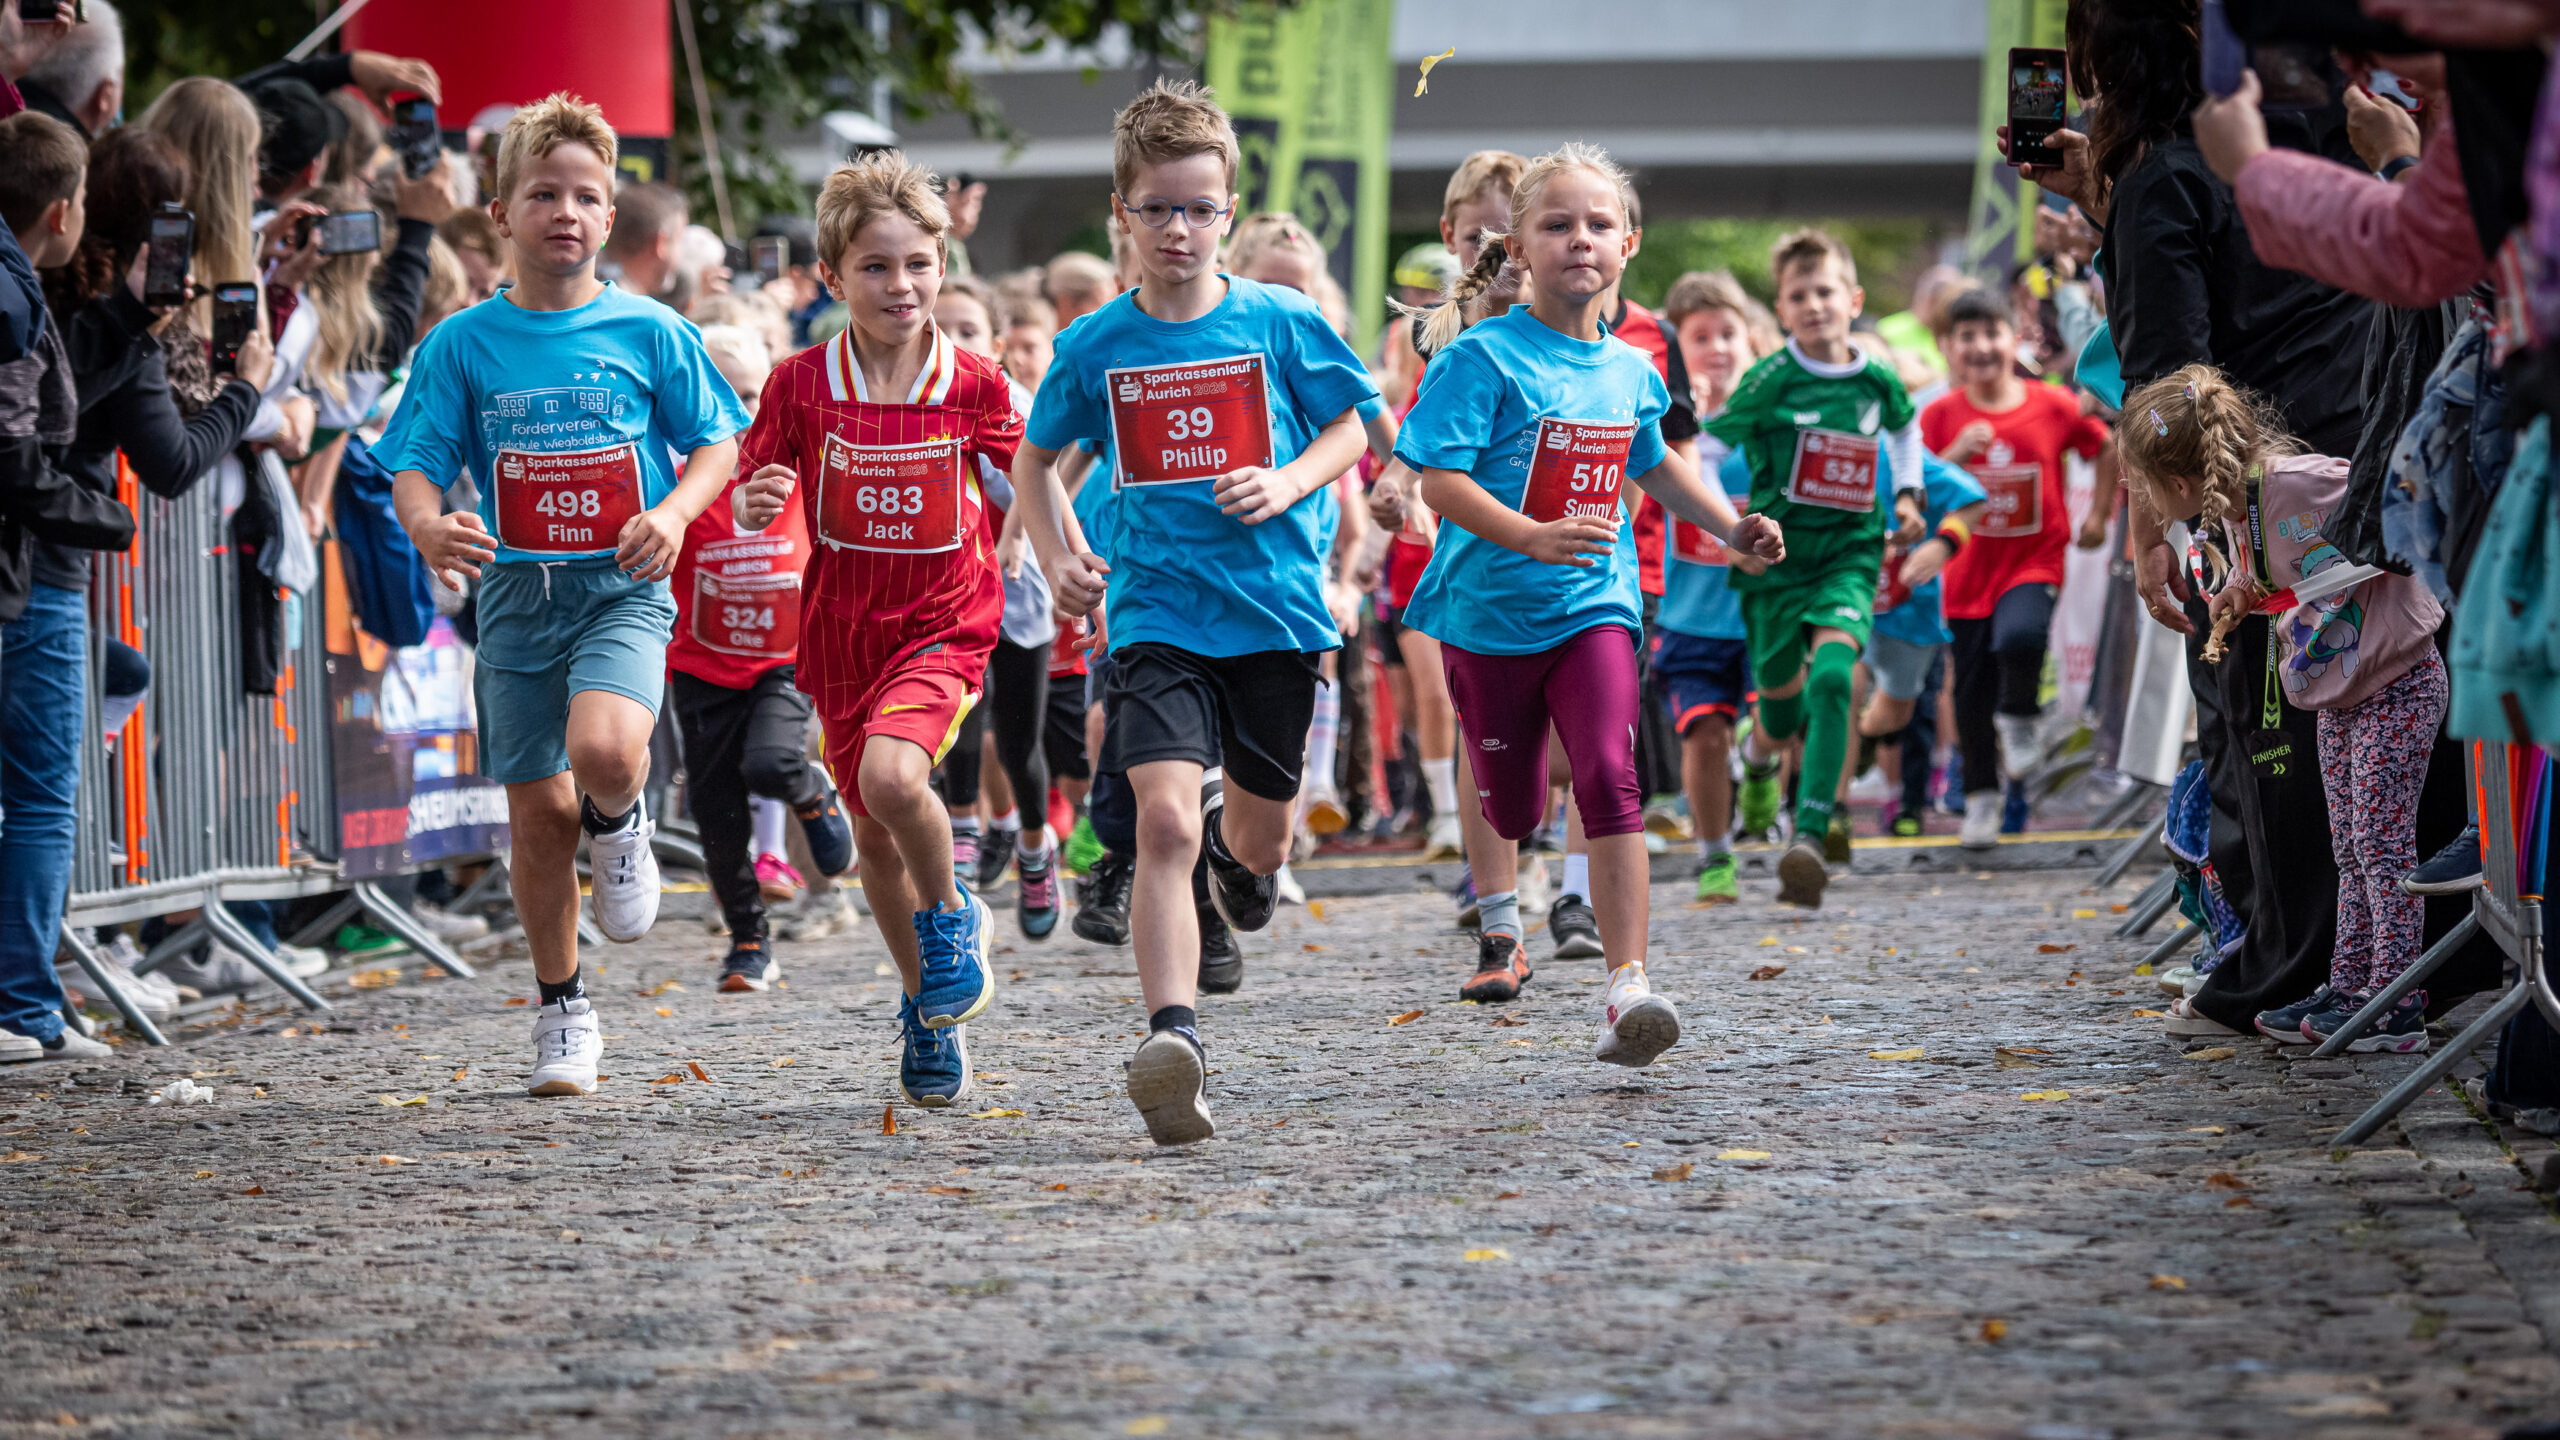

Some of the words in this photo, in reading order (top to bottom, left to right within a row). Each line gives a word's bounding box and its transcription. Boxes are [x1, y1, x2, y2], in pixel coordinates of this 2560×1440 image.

[1143, 360, 1251, 387] Sparkassenlauf
[1146, 385, 1191, 401] Aurich
[1193, 381, 1227, 396] 2026
[512, 418, 601, 436] Förderverein
[1166, 406, 1214, 440] 39
[543, 434, 615, 451] Wiegboldsbur
[1571, 442, 1607, 454] Aurich
[527, 448, 626, 471] Sparkassenlauf
[851, 446, 952, 464] Sparkassenlauf
[1161, 445, 1228, 470] Philip
[528, 470, 571, 482] Aurich
[851, 465, 896, 477] Aurich
[897, 464, 928, 477] 2026
[1570, 463, 1619, 492] 510
[1823, 458, 1870, 485] 524
[535, 489, 601, 518] 498
[856, 486, 924, 515] 683
[1563, 498, 1612, 520] Sunny
[548, 524, 593, 542] Finn
[864, 520, 914, 540] Jack
[2249, 504, 2262, 551] FINISHER
[721, 605, 775, 630] 324
[2251, 744, 2292, 766] FINISHER
